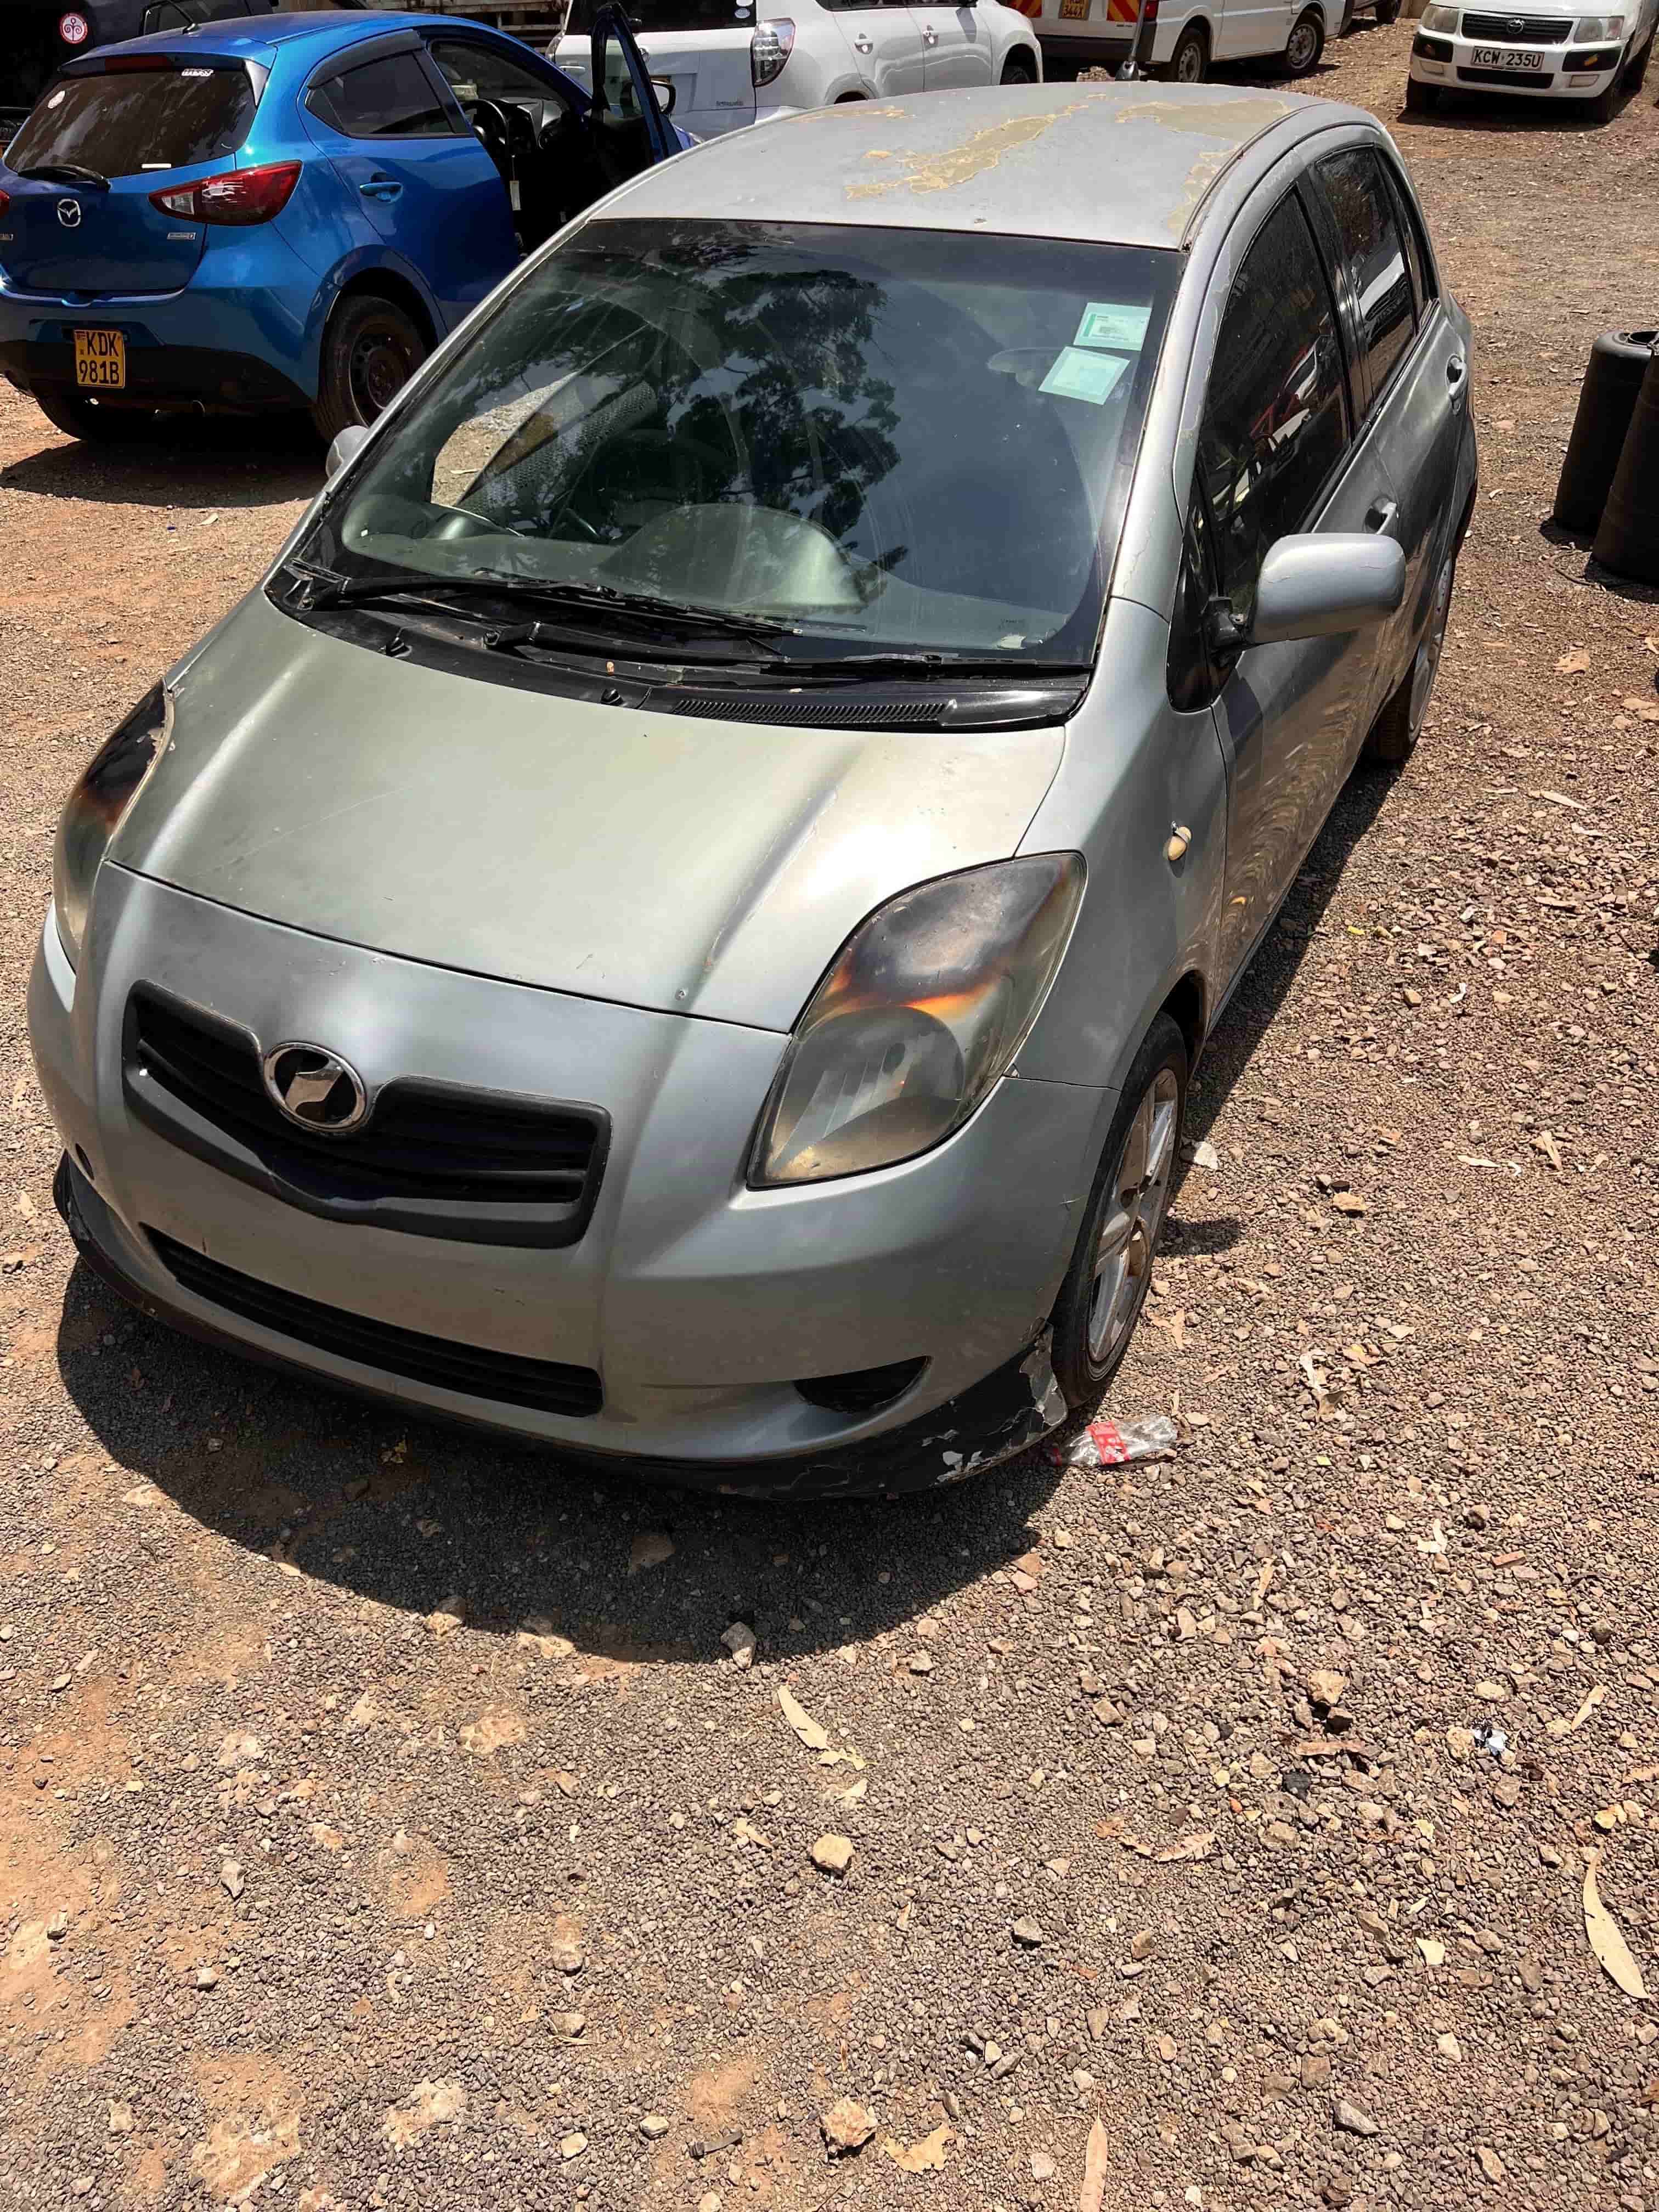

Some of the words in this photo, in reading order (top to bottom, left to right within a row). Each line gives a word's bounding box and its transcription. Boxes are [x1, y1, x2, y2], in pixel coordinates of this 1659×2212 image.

[1474, 49, 1501, 64] KCW
[1506, 53, 1541, 67] 235U
[88, 332, 119, 357] KDK
[79, 360, 119, 384] 981B
